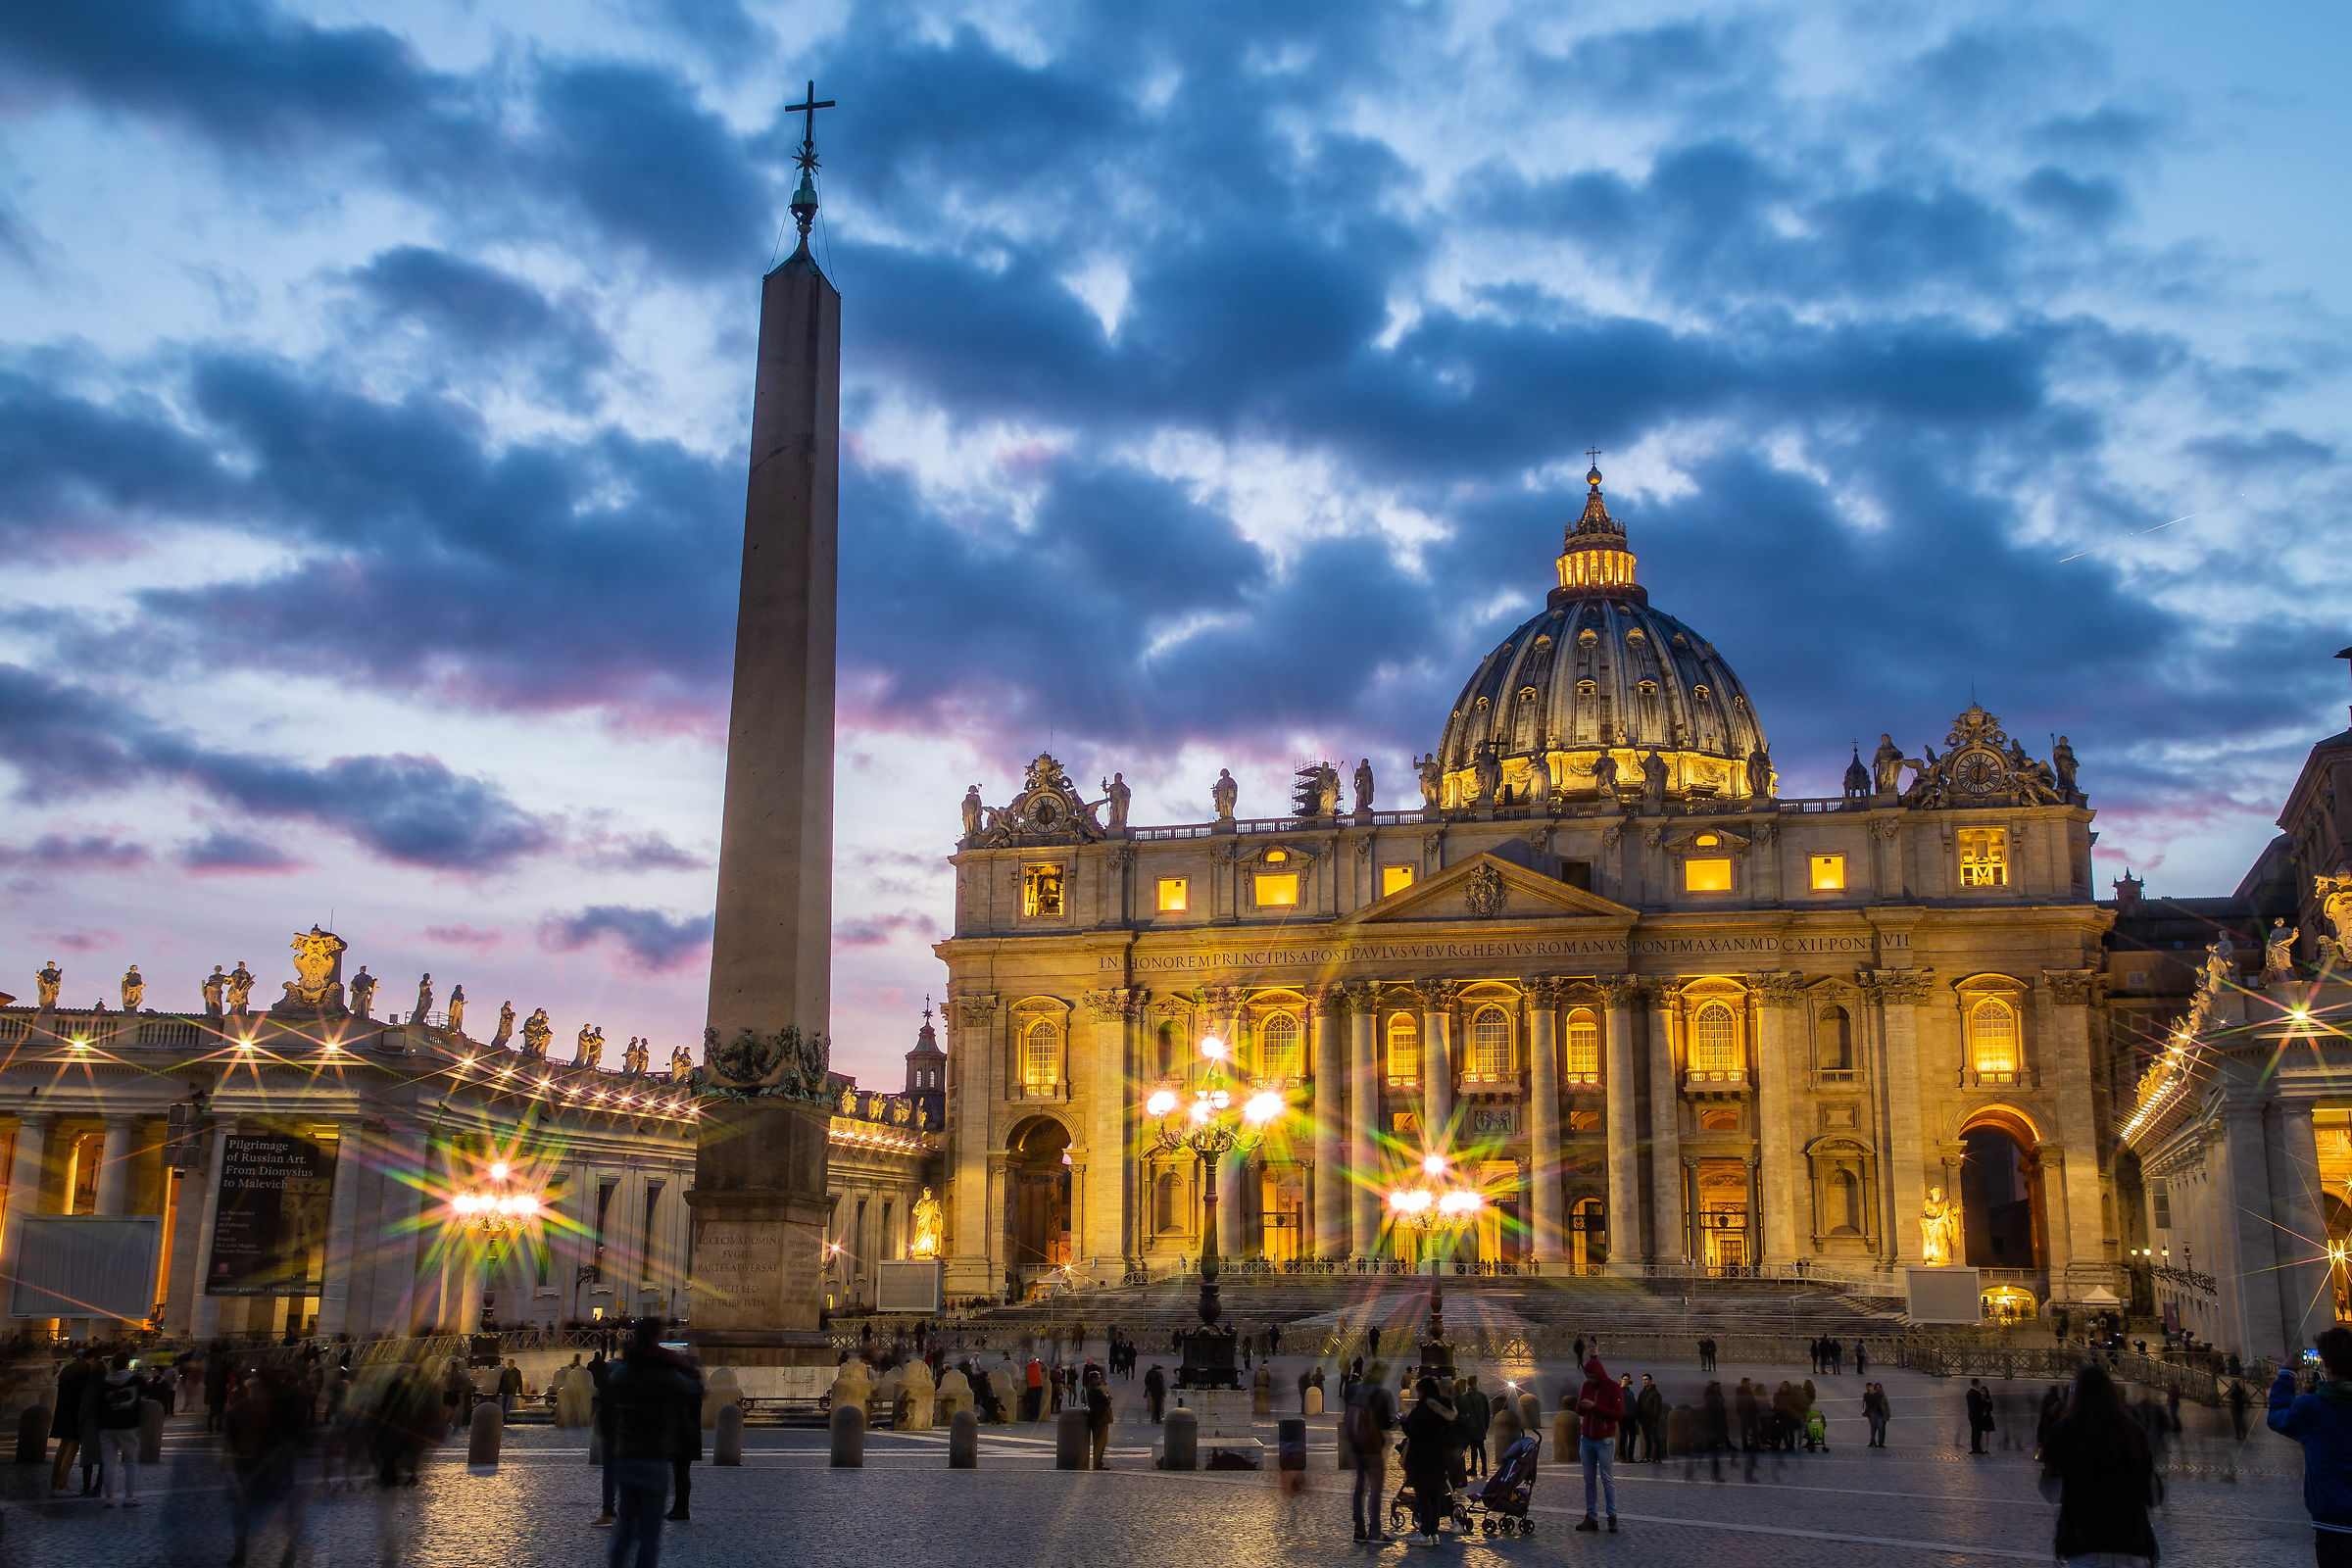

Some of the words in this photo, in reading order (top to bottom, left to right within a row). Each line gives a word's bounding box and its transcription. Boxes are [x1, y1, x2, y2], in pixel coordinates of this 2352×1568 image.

[1100, 956, 1118, 968] IN
[1130, 956, 1210, 969] HONOREM
[1213, 951, 1297, 965] PRINCIPIS
[1298, 949, 1351, 962] APOST
[1351, 946, 1407, 959] PAVLVS
[1426, 943, 1532, 957] BVRGHESIVS
[1537, 939, 1627, 955] ROMANVS
[1883, 933, 1910, 947] VII
[228, 1139, 288, 1152] Pilgrimage
[226, 1152, 239, 1162] of
[241, 1153, 284, 1163] Russian
[286, 1154, 307, 1164] Art.
[225, 1164, 256, 1175] From
[259, 1166, 314, 1178] Dionysius
[223, 1179, 235, 1188] to
[237, 1178, 288, 1190] Malevich
